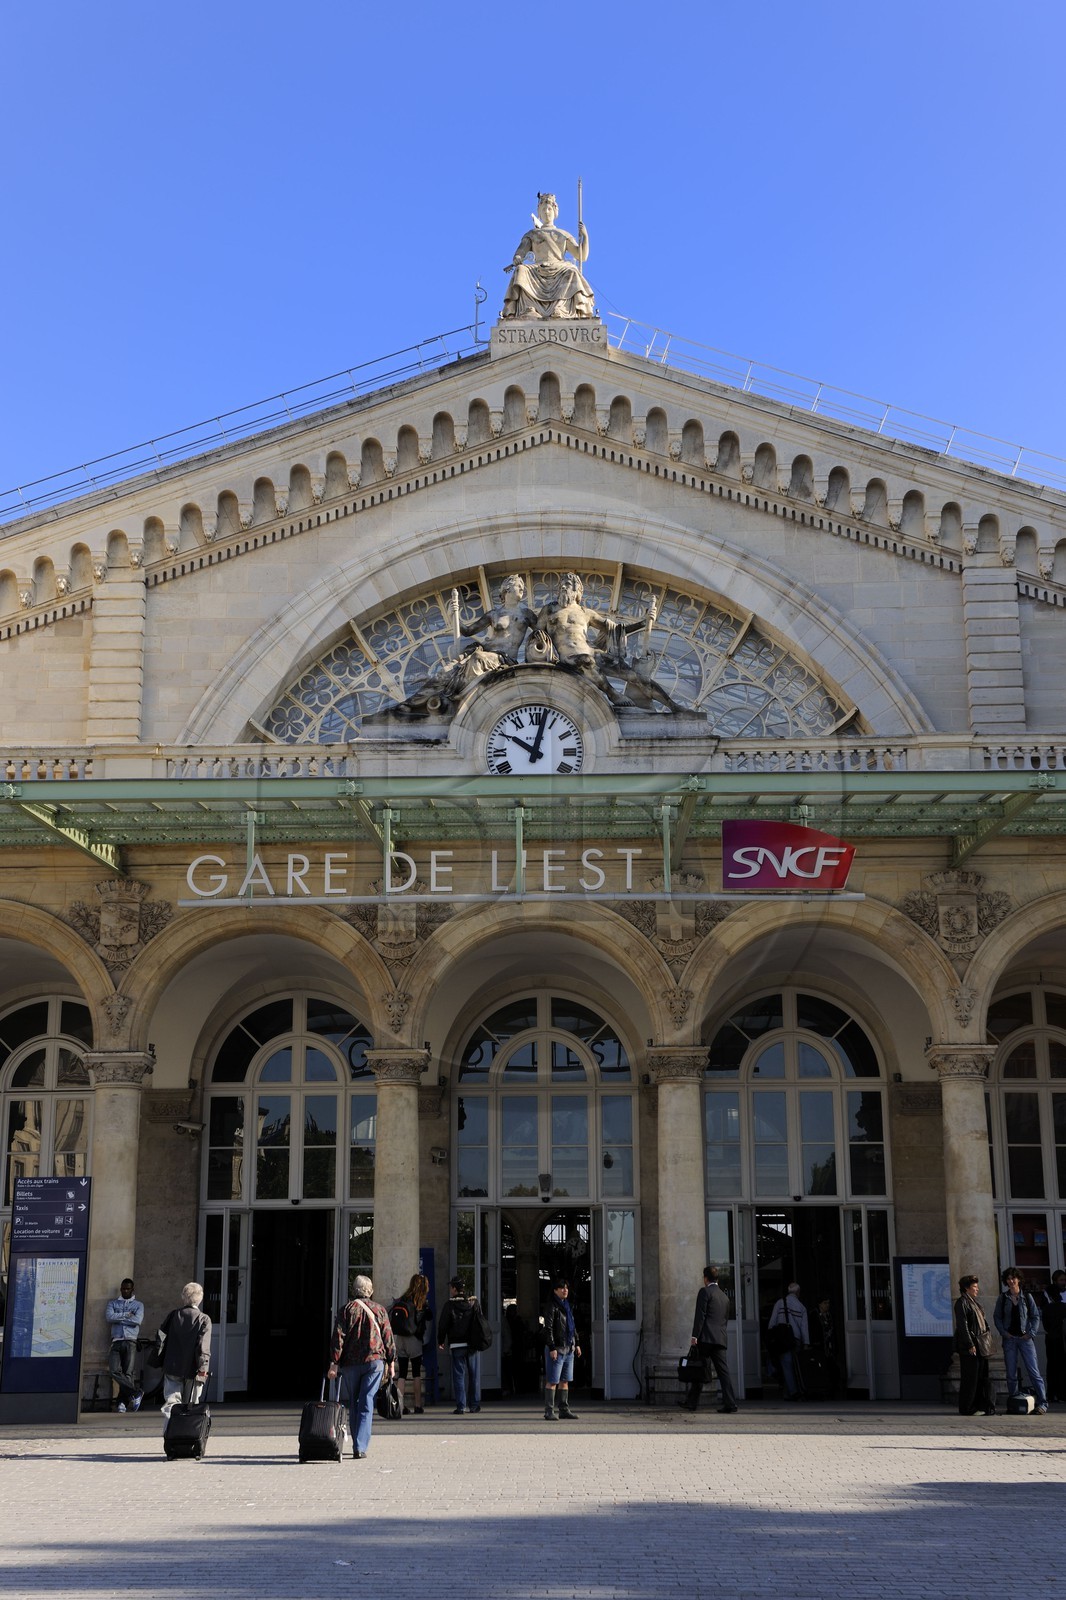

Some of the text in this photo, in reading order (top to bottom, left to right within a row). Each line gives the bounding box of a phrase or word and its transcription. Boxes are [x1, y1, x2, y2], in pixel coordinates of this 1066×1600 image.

[498, 328, 601, 344] STRASBOVRG
[186, 853, 348, 896] GARE
[386, 850, 453, 892] DE
[728, 847, 847, 878] SNCF
